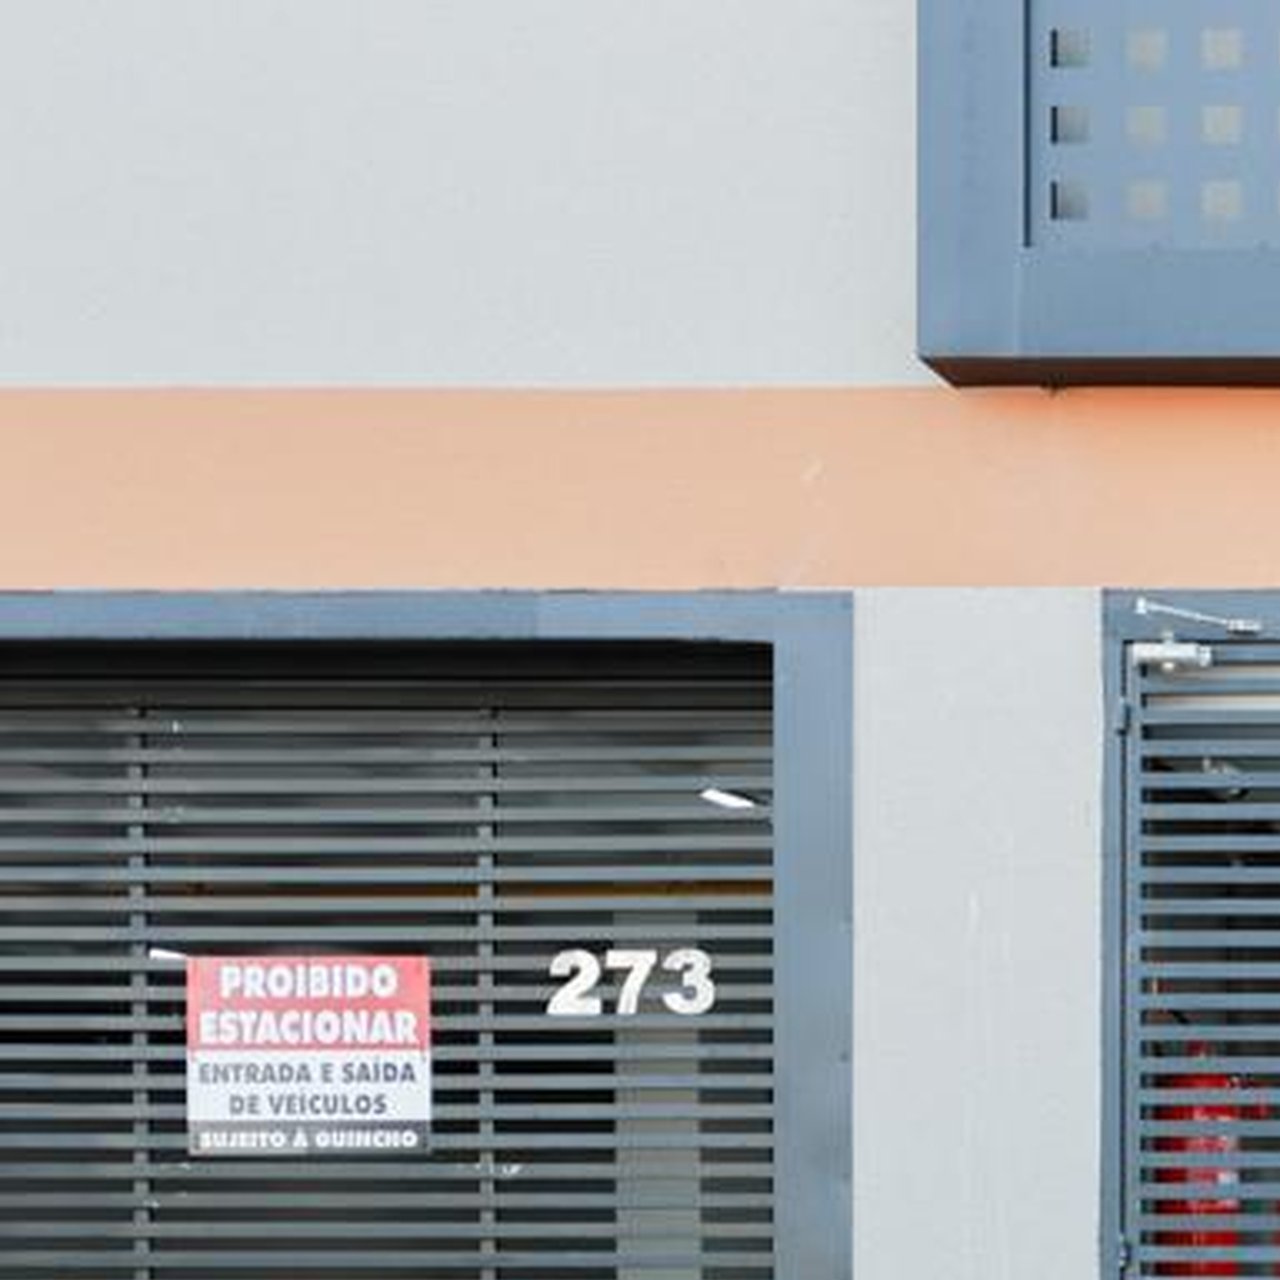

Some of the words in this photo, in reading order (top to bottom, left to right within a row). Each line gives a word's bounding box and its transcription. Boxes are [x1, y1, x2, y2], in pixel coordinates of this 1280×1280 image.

[220, 964, 397, 998] PROIBIDO
[546, 949, 716, 1015] 273
[199, 1010, 419, 1045] ESTACIONAR
[199, 1062, 312, 1084] ENTRADA
[321, 1062, 336, 1083] E
[342, 1056, 416, 1083] SAÍDA
[229, 1094, 260, 1115] DE
[268, 1090, 388, 1116] VEÍCULOS
[200, 1129, 286, 1149] SUJEITO
